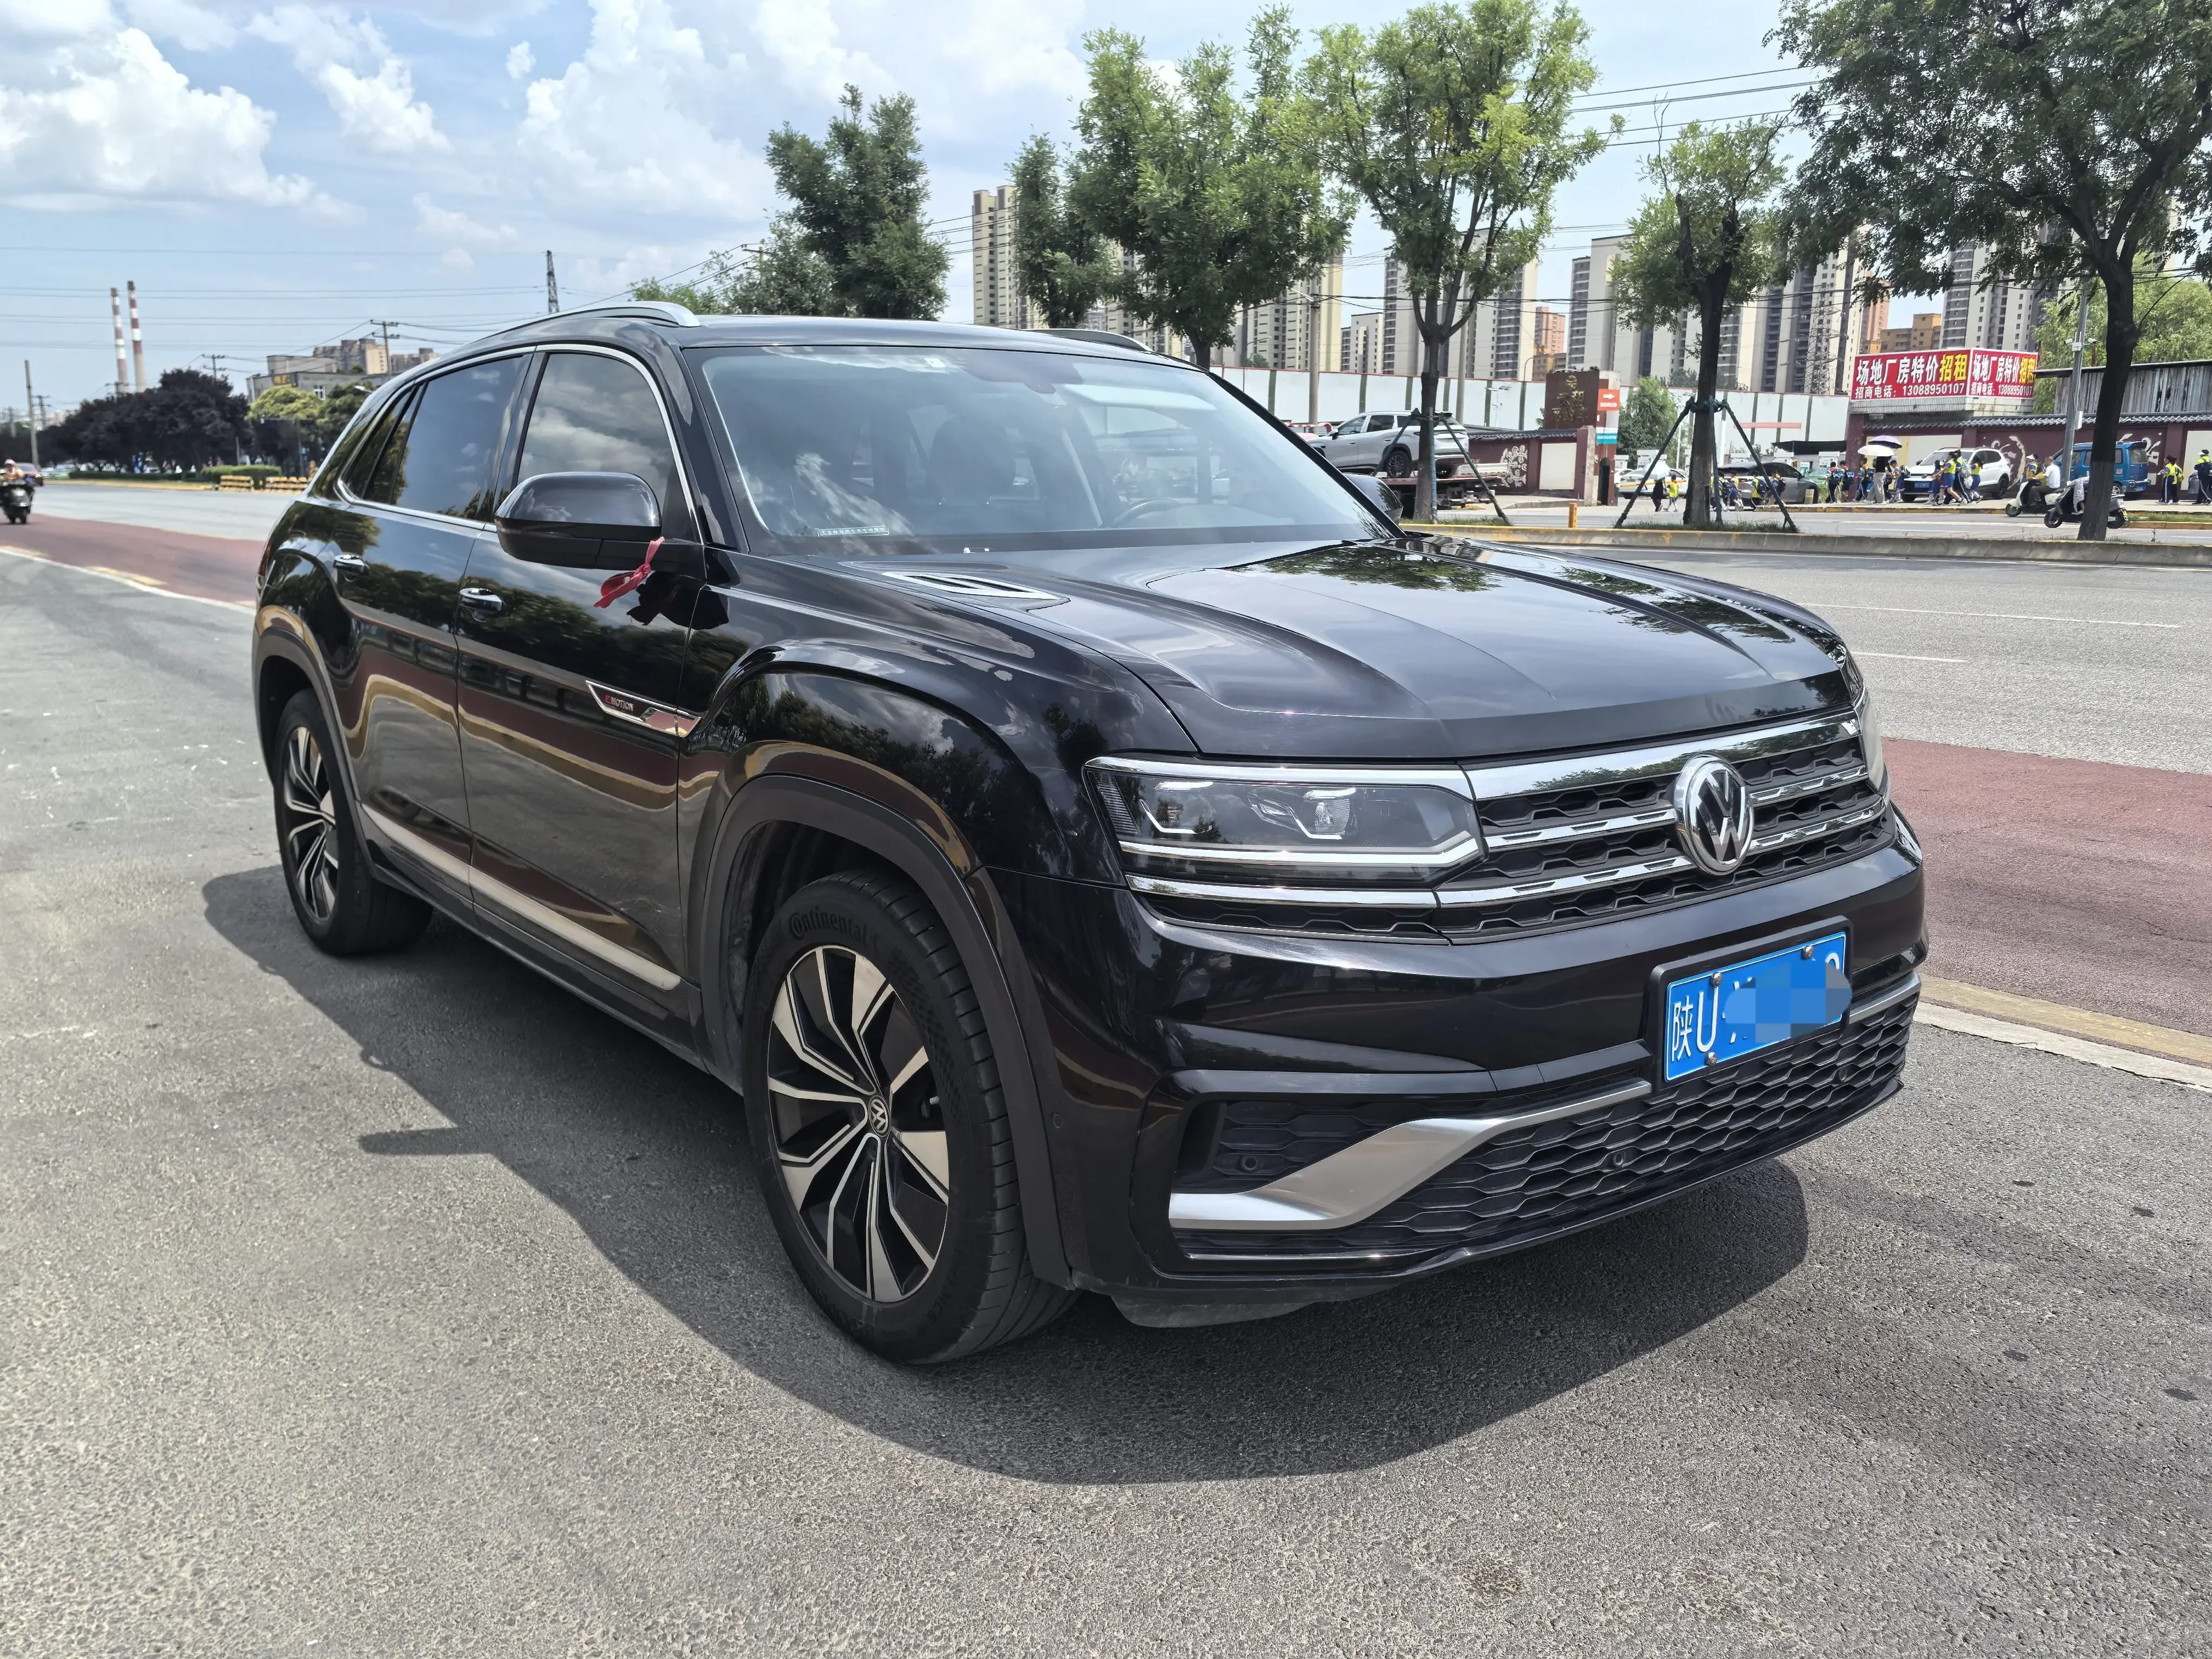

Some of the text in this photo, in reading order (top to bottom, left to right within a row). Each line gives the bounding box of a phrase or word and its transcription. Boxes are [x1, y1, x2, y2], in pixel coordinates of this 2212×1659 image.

[1856, 354, 1968, 386] 场地厂房特价招租
[1903, 383, 1965, 396] 13088950107
[789, 906, 867, 945] Continental
